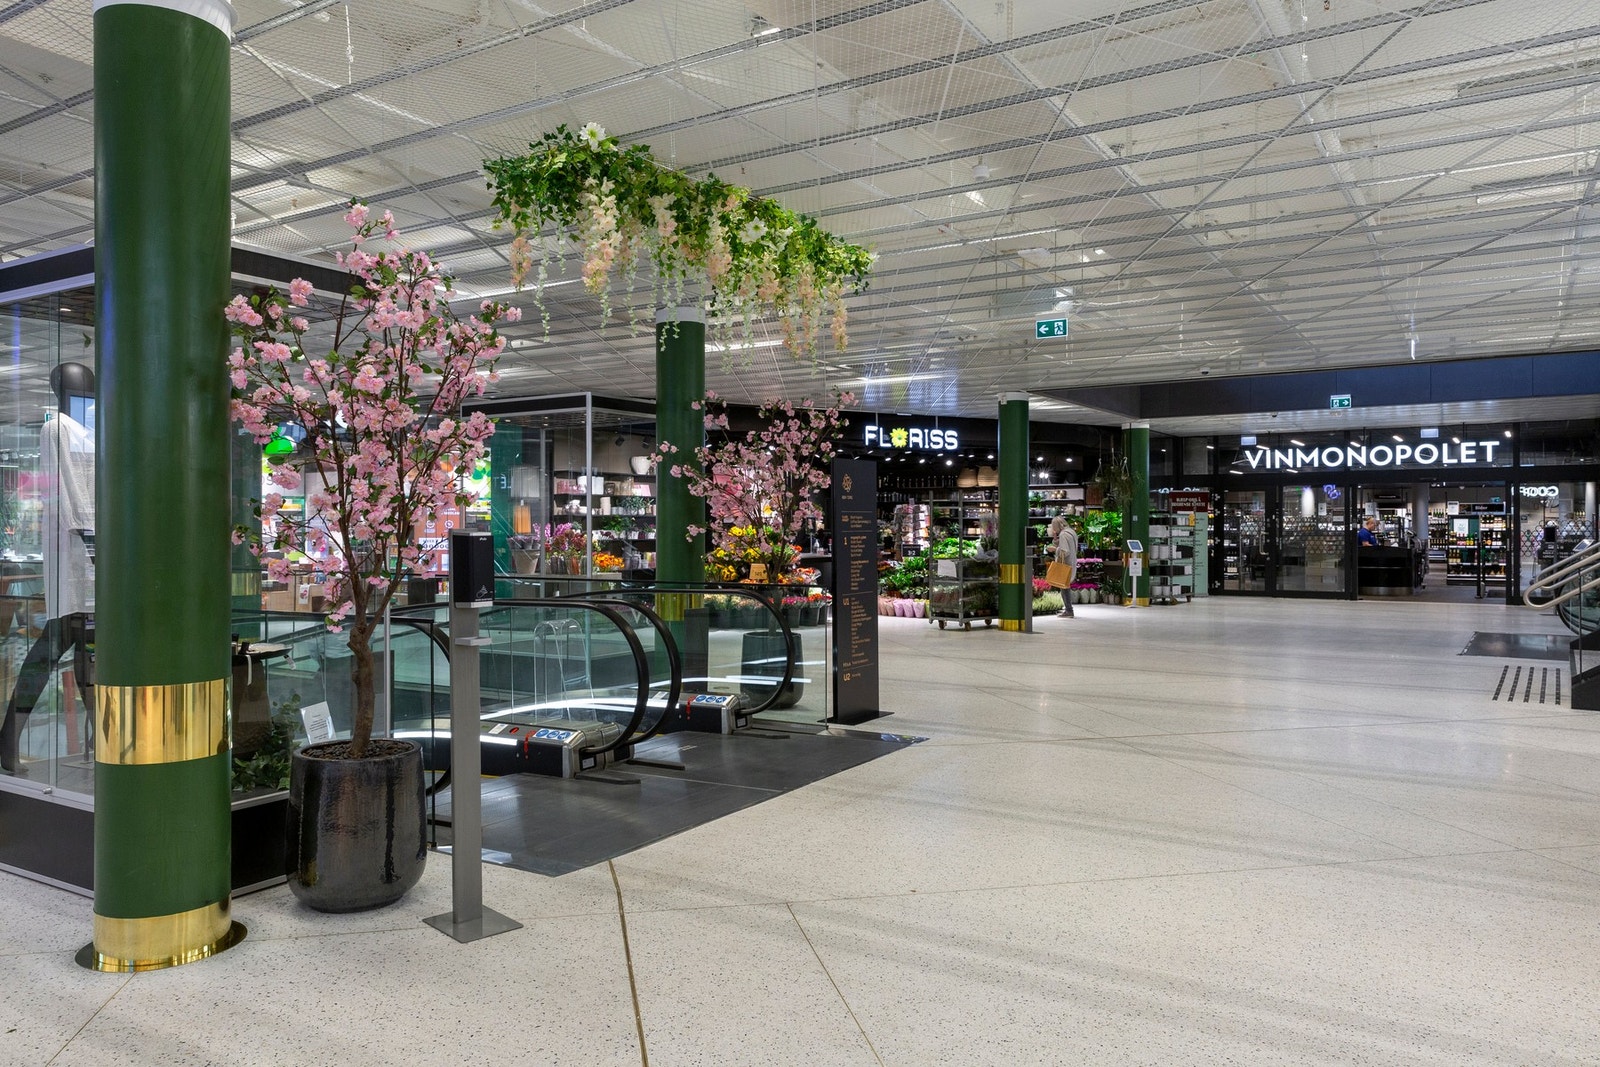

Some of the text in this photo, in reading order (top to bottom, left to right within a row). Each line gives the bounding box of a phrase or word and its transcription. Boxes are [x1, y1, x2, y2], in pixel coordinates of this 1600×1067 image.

[865, 425, 959, 451] FLORISS
[1245, 441, 1500, 470] VINMONOPOLET
[843, 672, 851, 682] U2
